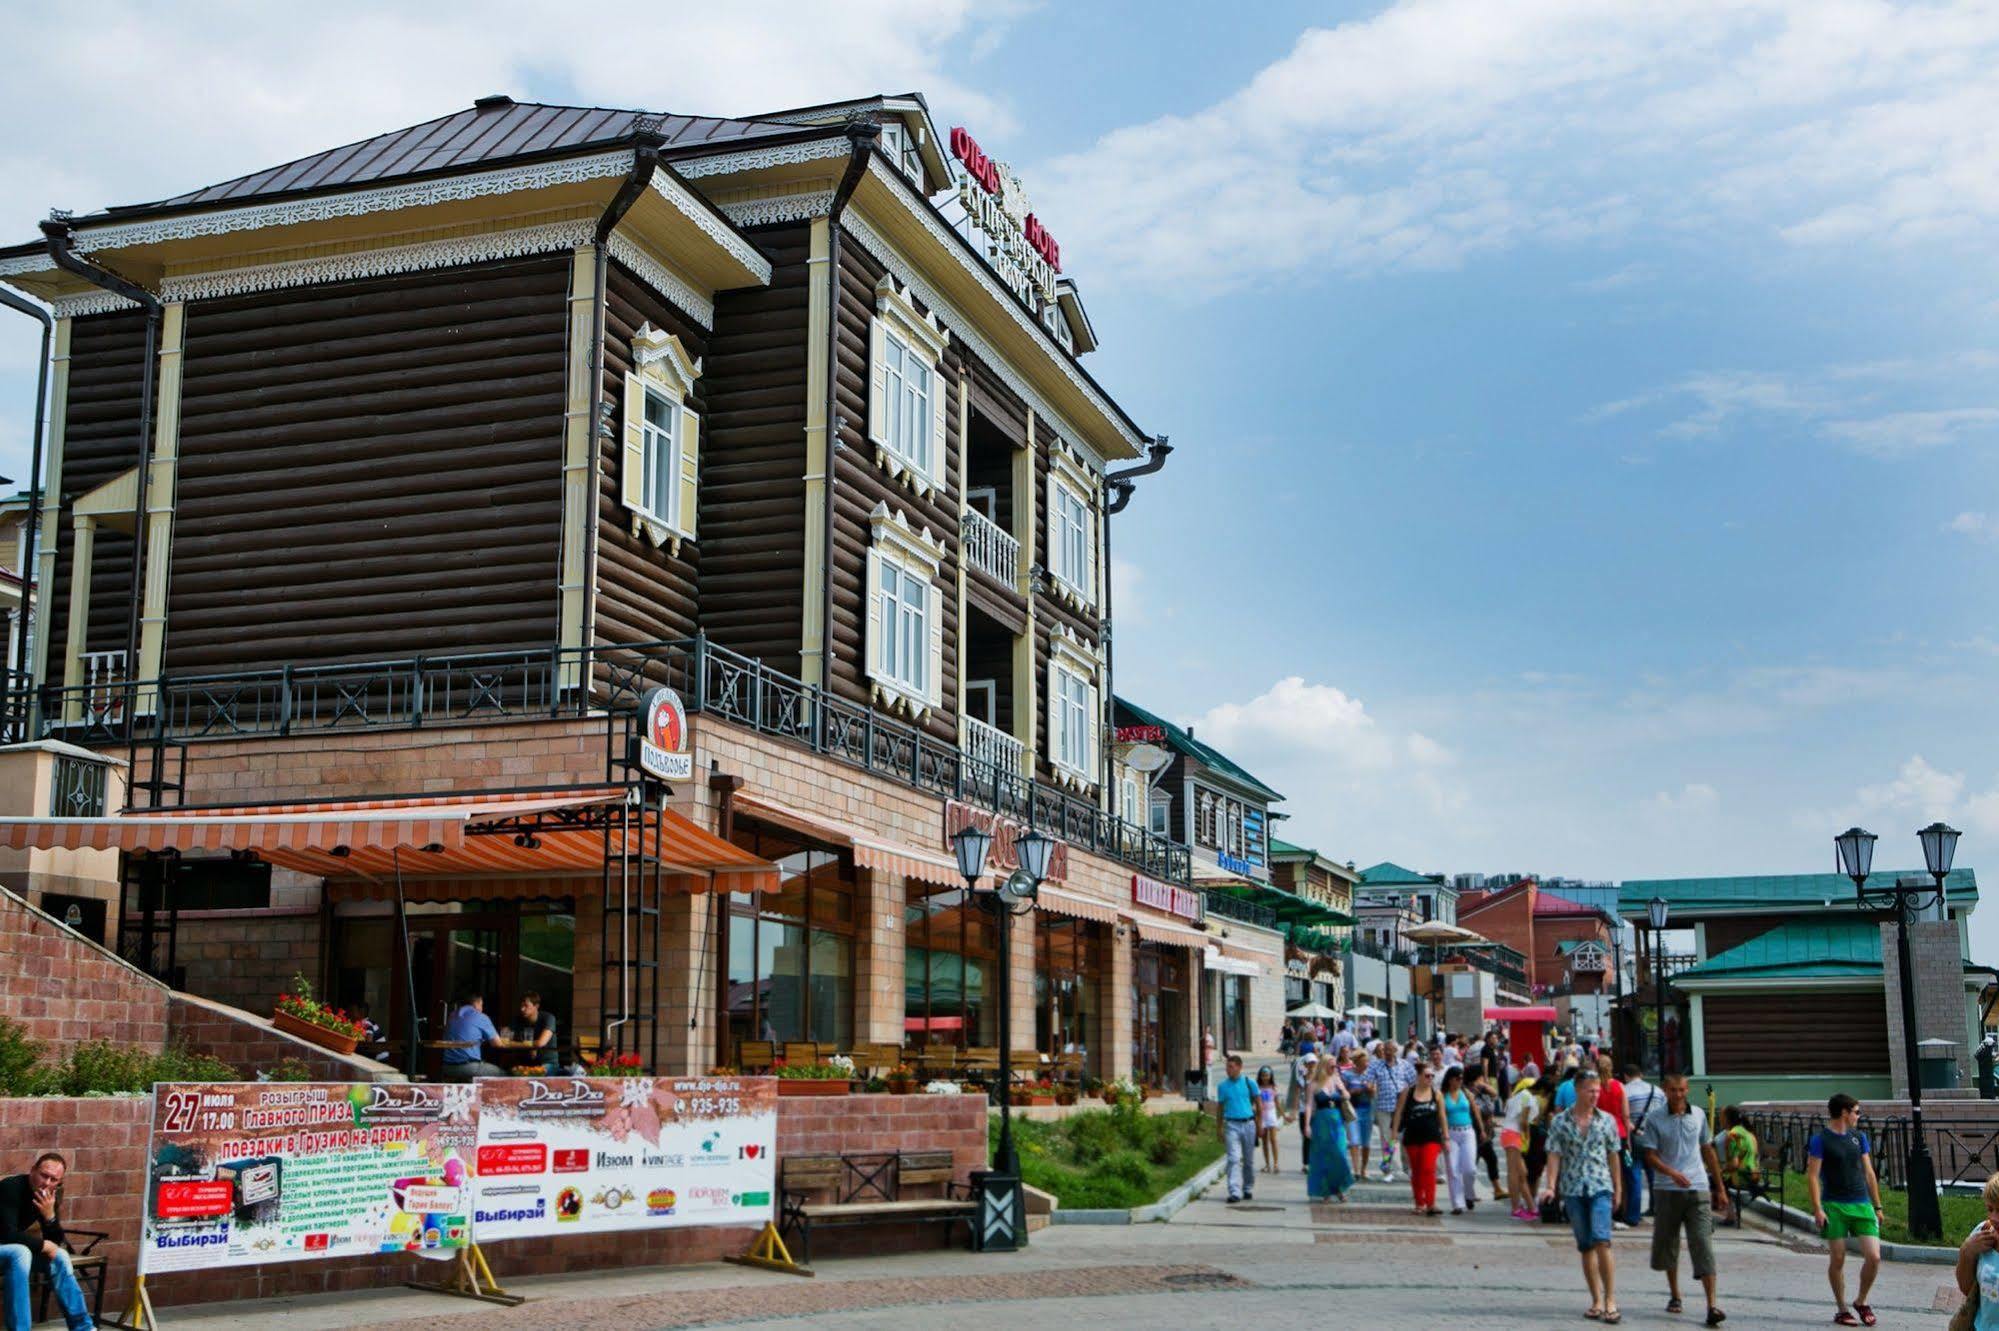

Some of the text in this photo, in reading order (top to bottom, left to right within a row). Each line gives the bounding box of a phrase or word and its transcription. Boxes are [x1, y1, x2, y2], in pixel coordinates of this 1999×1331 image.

[951, 127, 999, 194] ОТЕЛЬ
[1025, 213, 1062, 274] HOTEL
[674, 1080, 740, 1093] www.djo-djo.ru
[164, 1092, 201, 1132] 27
[243, 1101, 354, 1129] Главного ПРИЗА
[691, 1098, 740, 1114] 935-935
[203, 1112, 235, 1130] 17.00
[222, 1126, 411, 1159] поездки в Грузию на двоих
[475, 1206, 545, 1222] Выбирай
[157, 1231, 229, 1248] Выбирай
